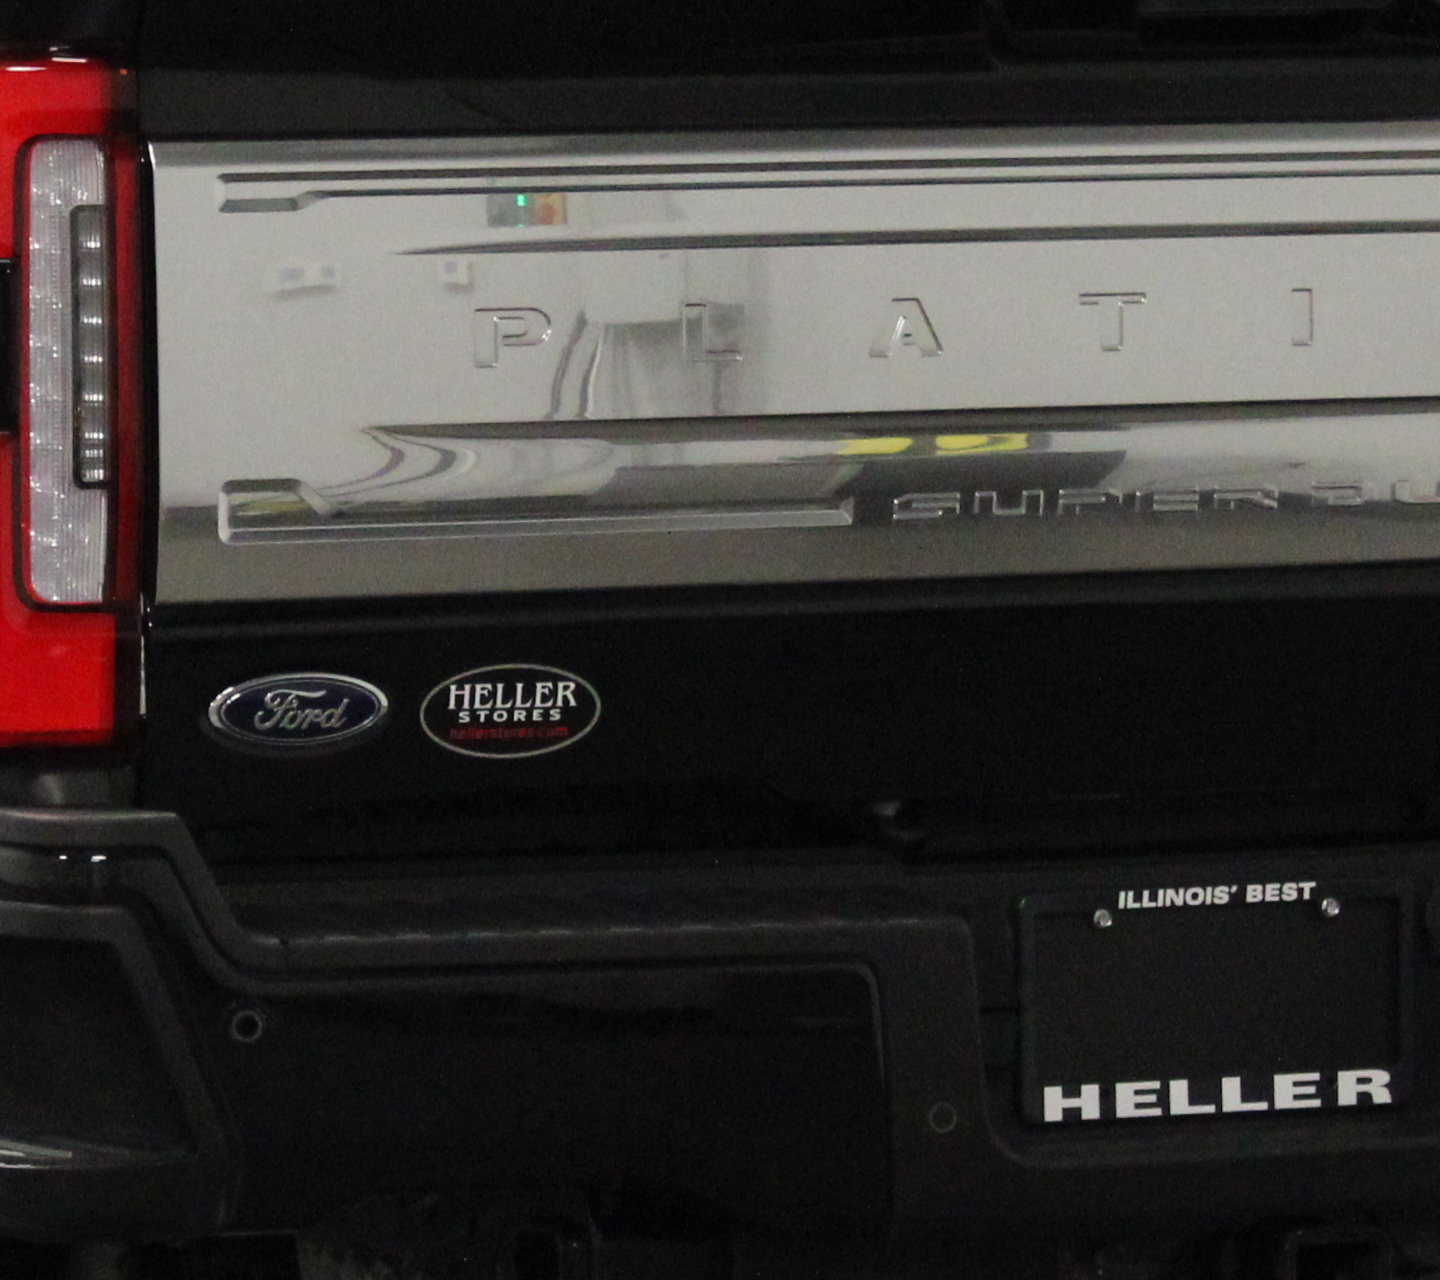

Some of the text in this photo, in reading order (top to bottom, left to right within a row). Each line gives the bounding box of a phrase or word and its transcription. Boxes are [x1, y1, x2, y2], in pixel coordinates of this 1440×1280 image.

[254, 688, 350, 732] Ford
[447, 681, 578, 710] HELLER
[458, 708, 562, 724] STORES
[1118, 881, 1317, 910] ILLINOIS' BEST
[1043, 1068, 1393, 1122] HELLER
